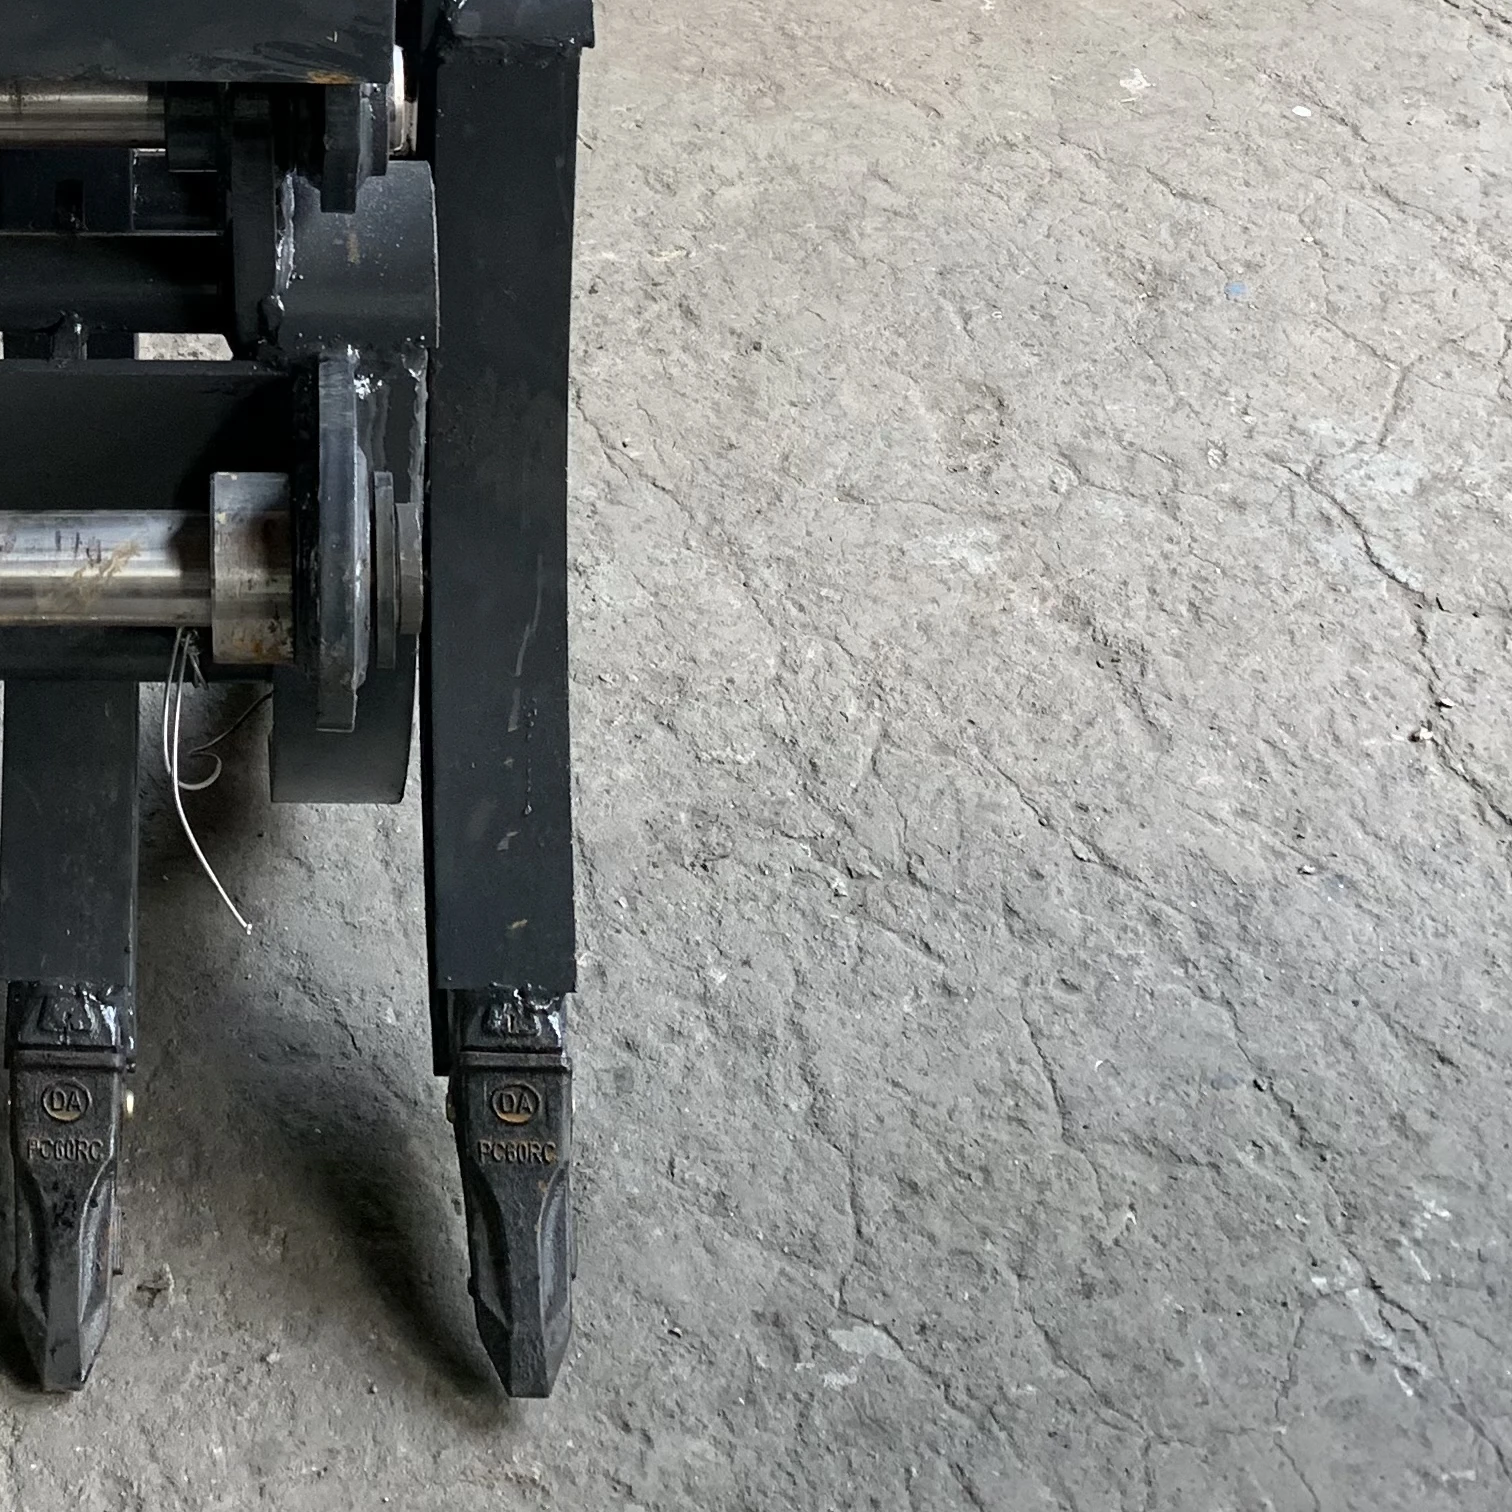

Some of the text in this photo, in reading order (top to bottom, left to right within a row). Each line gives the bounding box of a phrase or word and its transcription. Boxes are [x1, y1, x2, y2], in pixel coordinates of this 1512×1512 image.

[499, 1090, 534, 1115] DA
[27, 1136, 105, 1165] PC60RC
[477, 1138, 558, 1165] PC60RC
